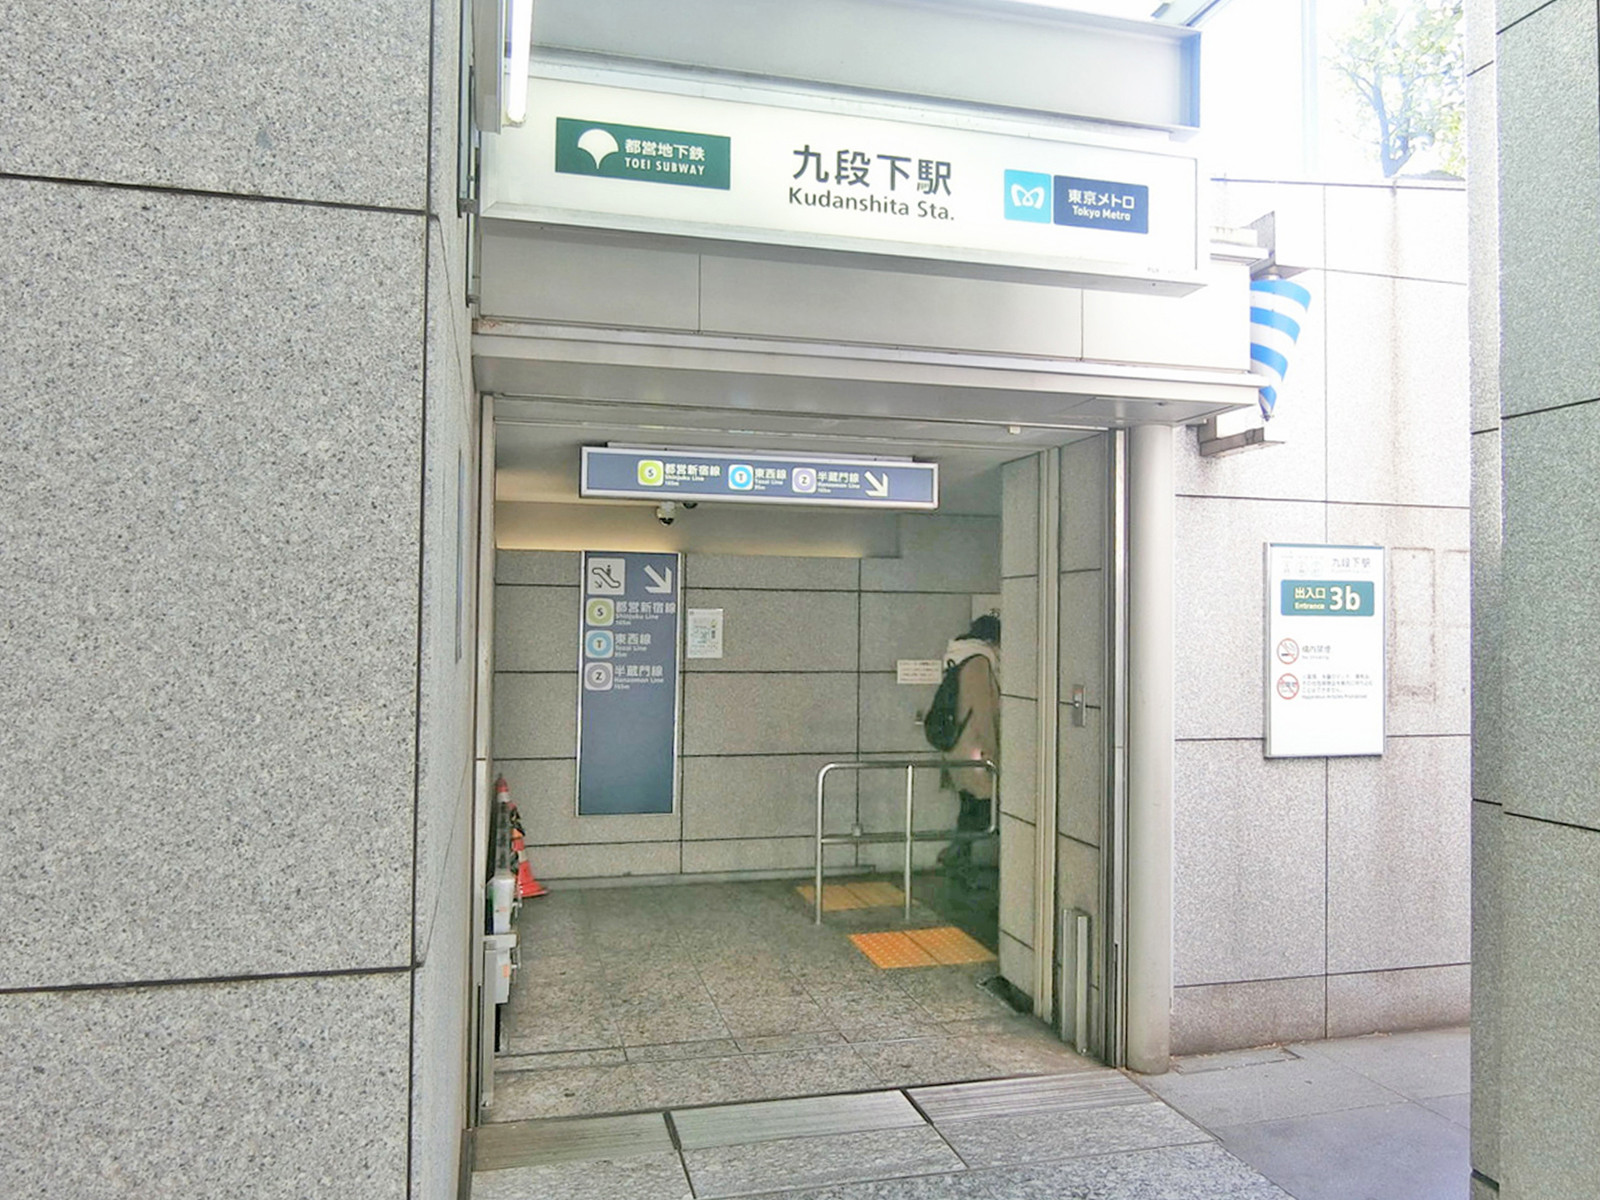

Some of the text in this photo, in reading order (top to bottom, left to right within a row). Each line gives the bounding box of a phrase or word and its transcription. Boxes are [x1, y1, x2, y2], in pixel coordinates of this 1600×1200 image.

[625, 139, 705, 161] 都営地下鉄
[625, 157, 705, 175] TOEI SUBWAY
[793, 144, 951, 196] 九段下駅
[789, 187, 954, 221] Kudanshita Sta.
[1068, 189, 1135, 209] 東京メトロ
[1072, 205, 1131, 221] Tokyo Metro
[1294, 587, 1326, 599] 出入口
[1329, 585, 1360, 611] 3b
